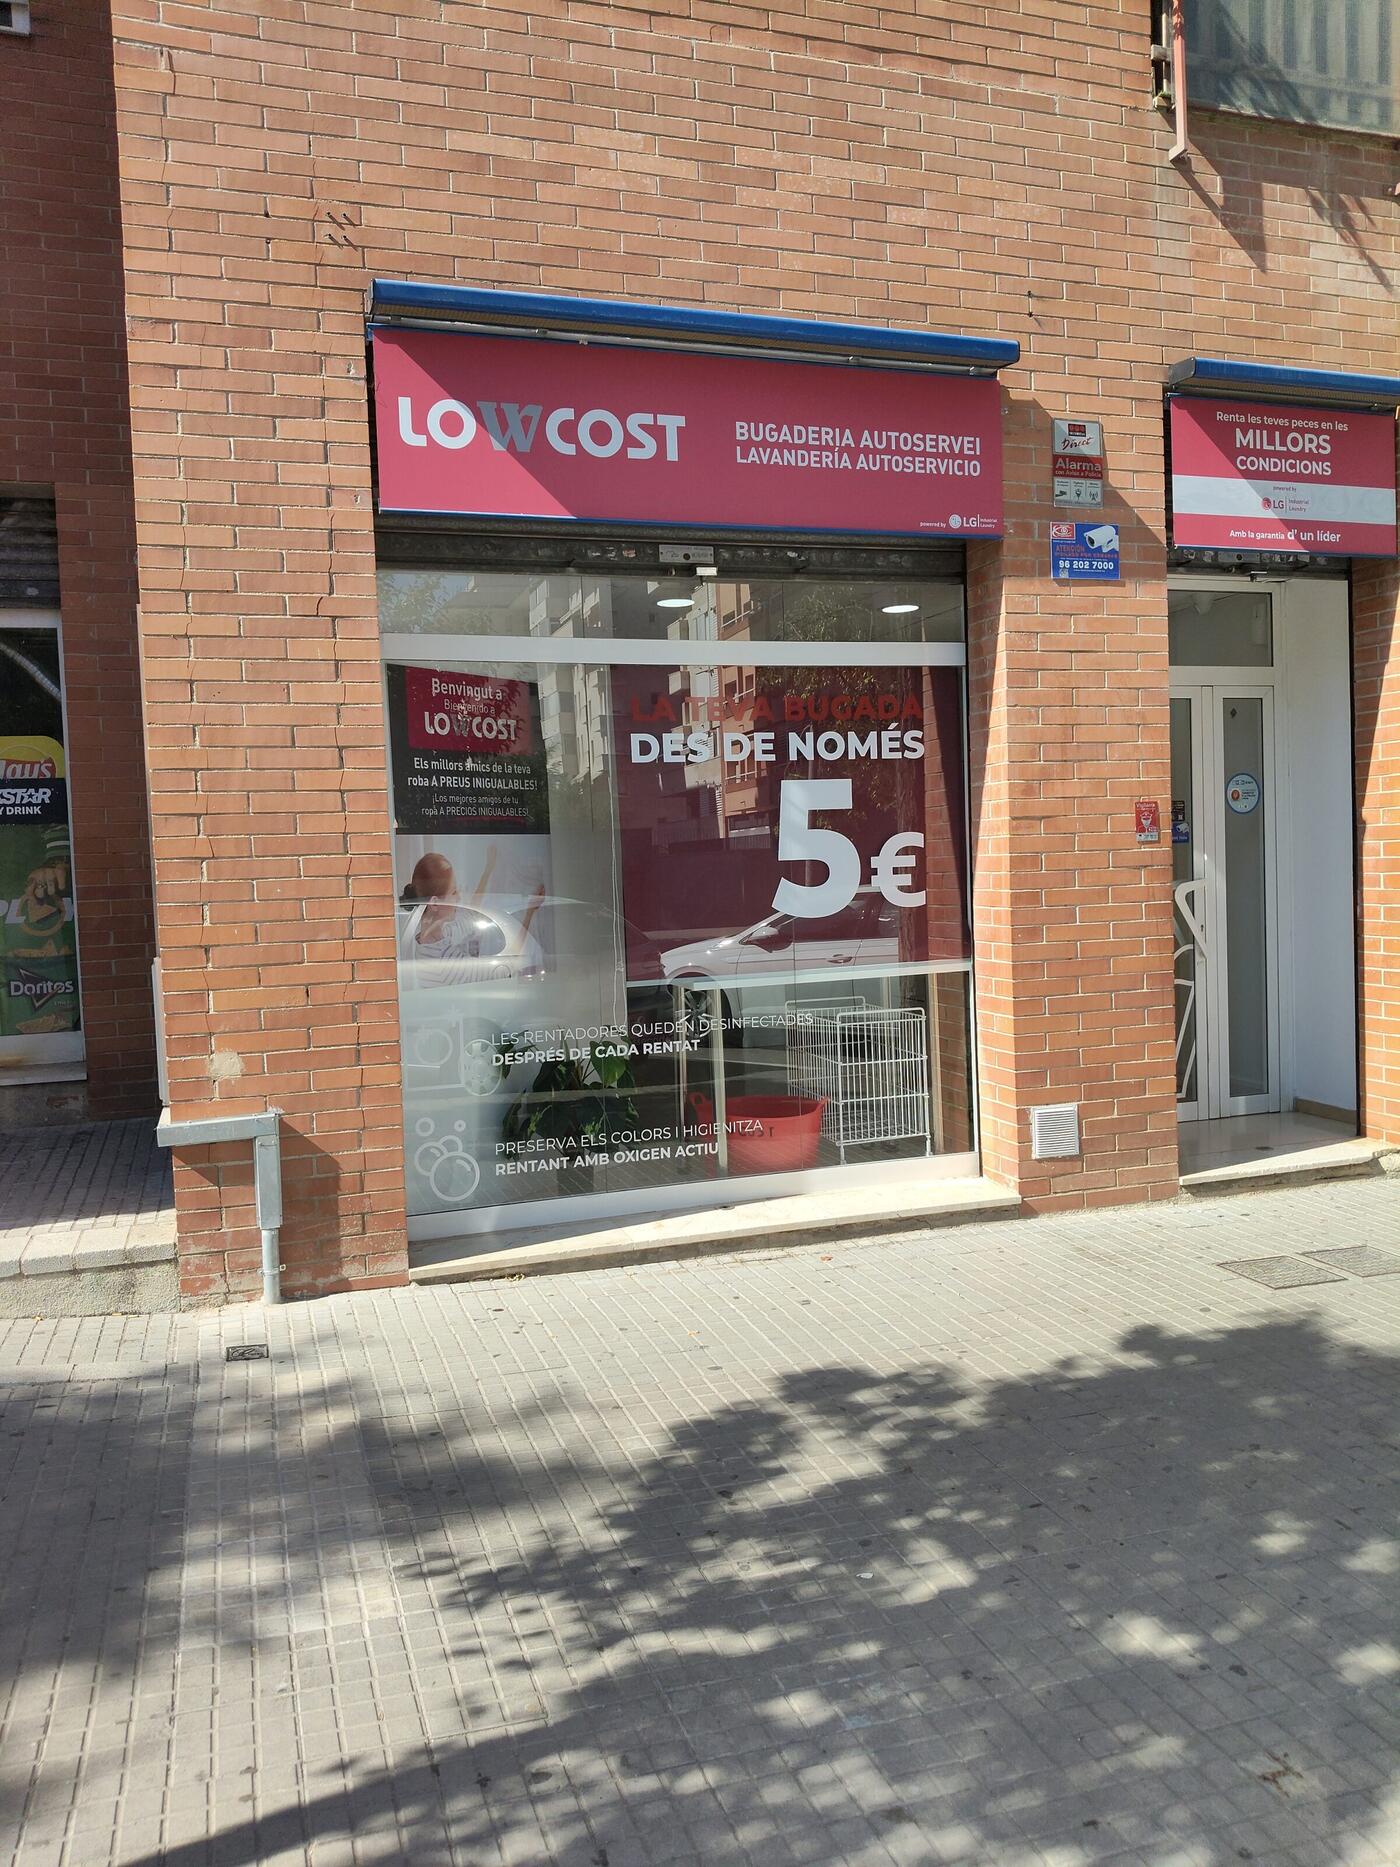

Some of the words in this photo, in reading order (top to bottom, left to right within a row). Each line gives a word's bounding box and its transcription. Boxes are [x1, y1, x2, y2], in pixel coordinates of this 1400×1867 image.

[399, 397, 686, 462] LOWCOST
[1216, 411, 1246, 424] Renta
[1248, 413, 1262, 425] les
[1263, 416, 1289, 427] teves
[1291, 419, 1319, 430] peces
[1321, 420, 1333, 430] en
[1335, 419, 1348, 431] les
[736, 421, 855, 448] BUGADERIA
[858, 428, 981, 456] AUTOSERVEI
[1235, 428, 1331, 455] MILLORS
[736, 444, 852, 470] LAVANDERÍA
[856, 451, 981, 477] AUTOSERVICIO
[1056, 458, 1102, 471] Alarma
[1236, 455, 1332, 475] CONDICIONS
[1273, 500, 1284, 509] LG
[963, 517, 977, 527] LG
[1230, 529, 1247, 538] Amb
[1248, 530, 1255, 538] la
[1300, 532, 1314, 541] un
[1316, 528, 1341, 543] líder
[1072, 561, 1089, 569] 202
[1092, 561, 1114, 570] 7000
[431, 677, 494, 702] Benvingut
[495, 690, 503, 701] a
[630, 695, 676, 722] LA
[685, 696, 774, 722] TEVA
[784, 695, 924, 722] BUGADA
[424, 711, 517, 741] LOWCOST
[630, 732, 711, 764] DES
[723, 732, 776, 763] DE
[789, 723, 925, 761] NOMÉS
[414, 757, 429, 769] Els
[431, 758, 463, 771] millors
[465, 760, 491, 773] amics
[492, 762, 503, 773] de
[504, 762, 513, 773] la
[514, 764, 531, 774] teva
[408, 776, 429, 787] roba
[431, 777, 438, 787] A
[440, 777, 471, 789] PREUS
[472, 778, 538, 791] INIGUALABLES!
[449, 794, 477, 805] mejores
[478, 795, 502, 806] amigos
[503, 796, 511, 804] de
[512, 796, 519, 805] tu
[6, 806, 42, 815] DRINK
[421, 805, 438, 817] ropa
[439, 806, 445, 816] A
[446, 806, 477, 816] PRECIOS
[478, 806, 529, 817] INIGUALABLES!
[10, 980, 74, 997] Doritos
[490, 1030, 520, 1048] LES
[523, 1024, 627, 1046] RENTADORES
[630, 1019, 697, 1039] QUEDEN
[698, 1011, 815, 1034] DESINFECTADES
[491, 1045, 566, 1067] DESPRÉS
[569, 1046, 592, 1062] DE
[594, 1043, 640, 1059] CADA
[642, 1037, 702, 1056] RENTAT
[494, 1136, 577, 1156] PRESERVA
[580, 1132, 608, 1149] ELS
[611, 1126, 673, 1146] COLORS
[683, 1118, 764, 1139] HIGIENITZA
[495, 1156, 571, 1178] RENTANT
[573, 1151, 609, 1169] AMB
[612, 1146, 671, 1167] OXIGEN
[674, 1141, 720, 1161] ACTIU
